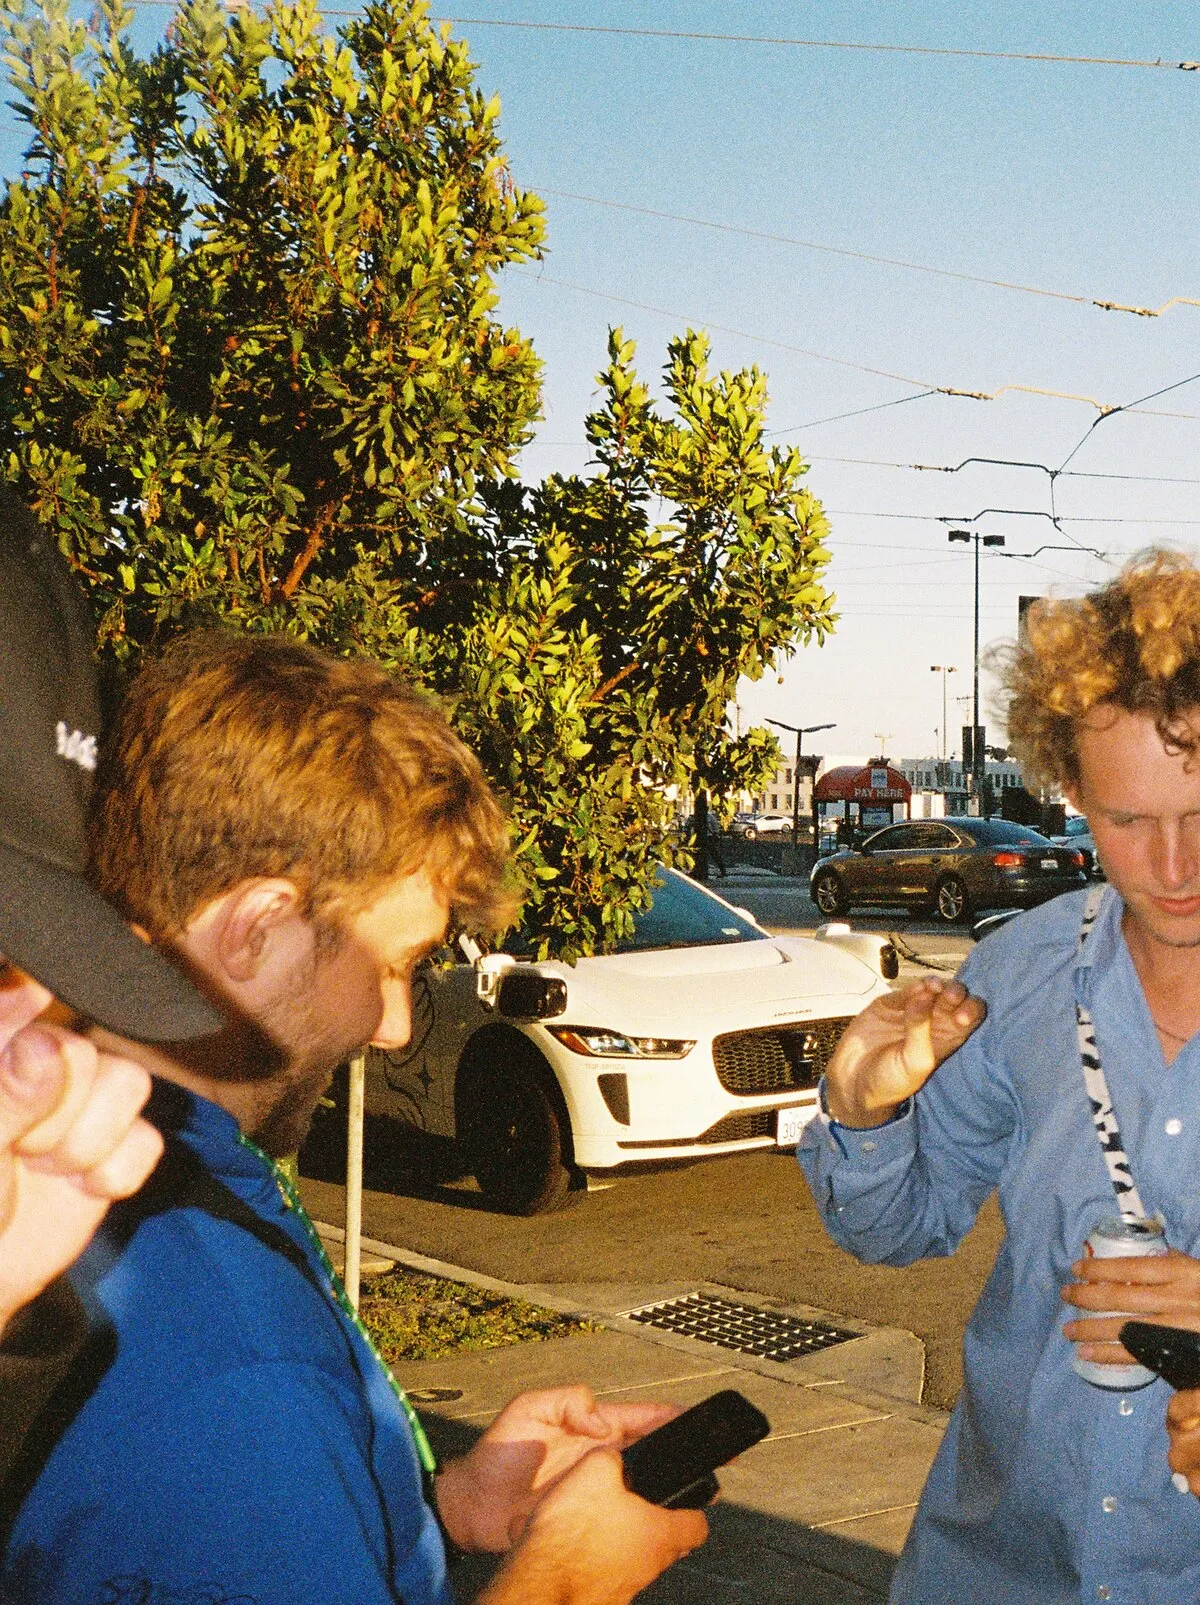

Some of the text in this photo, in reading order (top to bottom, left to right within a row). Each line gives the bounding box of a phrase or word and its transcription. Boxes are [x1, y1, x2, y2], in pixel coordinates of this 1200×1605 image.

[854, 787, 872, 798] PAY
[877, 787, 904, 798] HERE
[782, 1119, 809, 1139] 309
